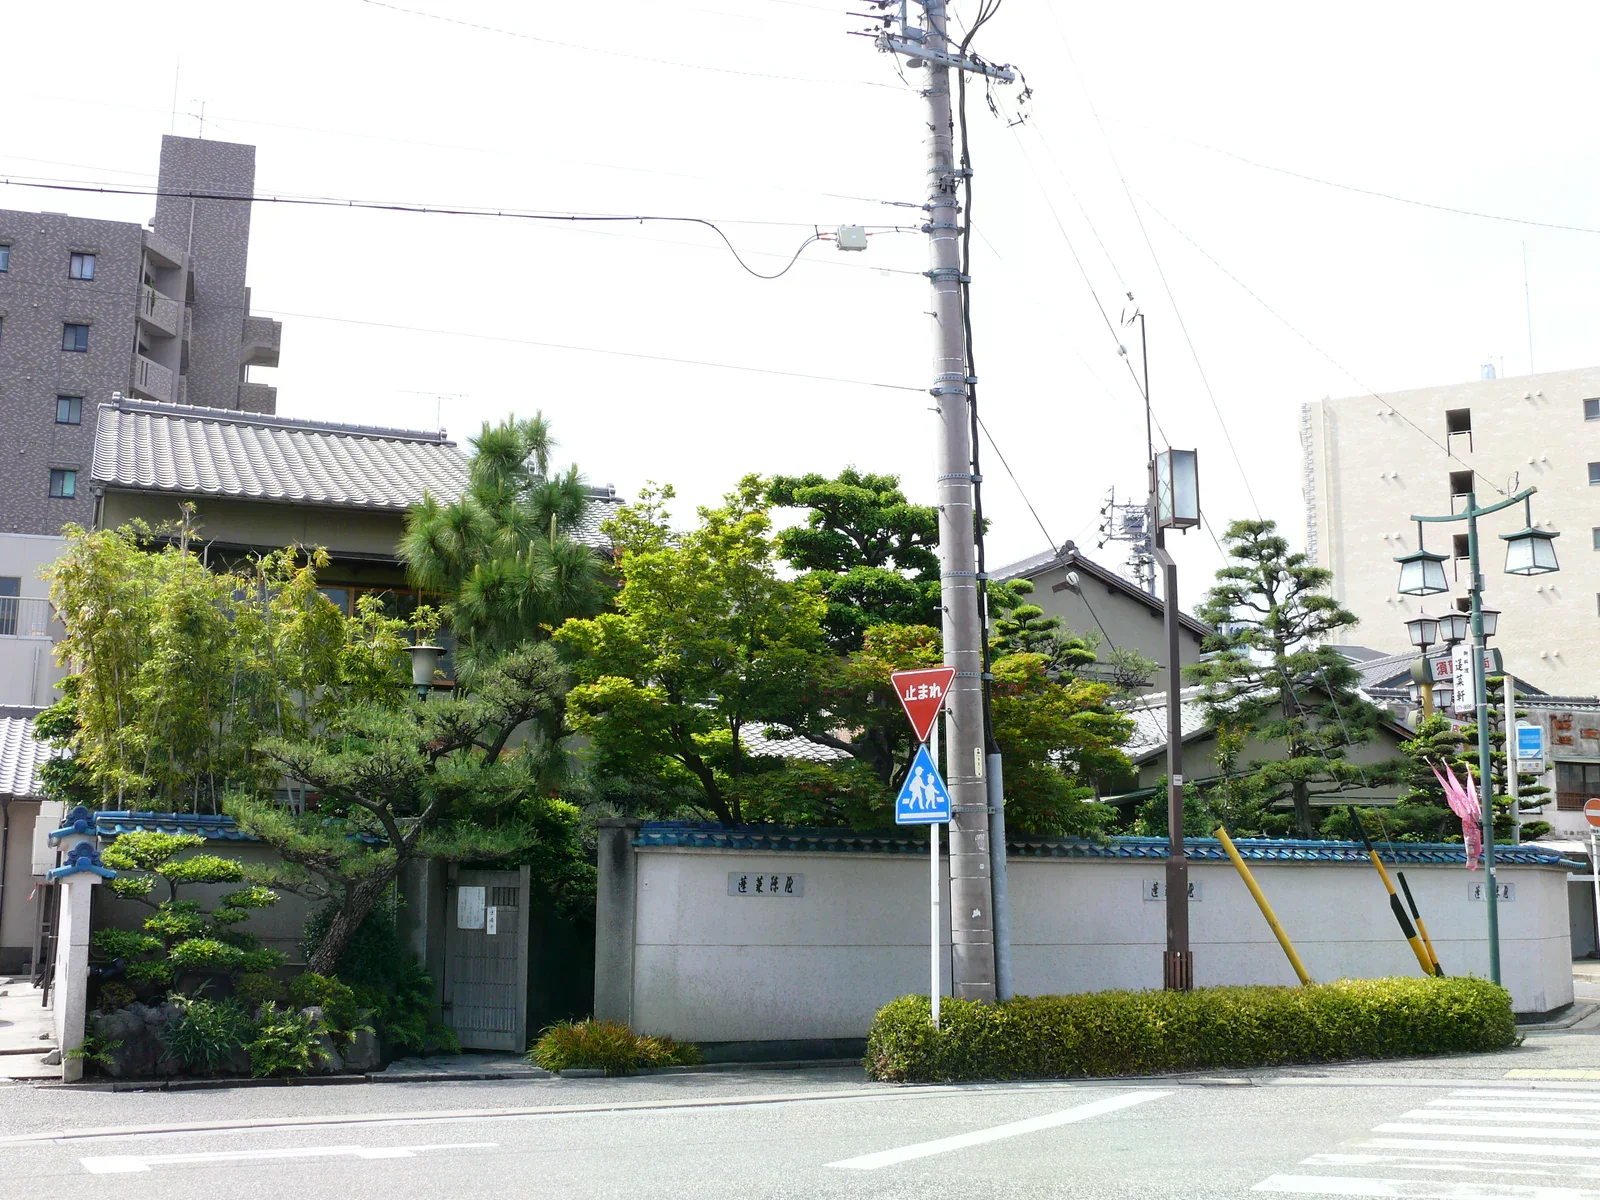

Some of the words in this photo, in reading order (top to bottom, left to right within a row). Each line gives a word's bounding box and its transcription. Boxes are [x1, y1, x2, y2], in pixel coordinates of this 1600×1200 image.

[904, 682, 942, 701] 止まれ
[1455, 658, 1466, 702] 蓬莱軒
